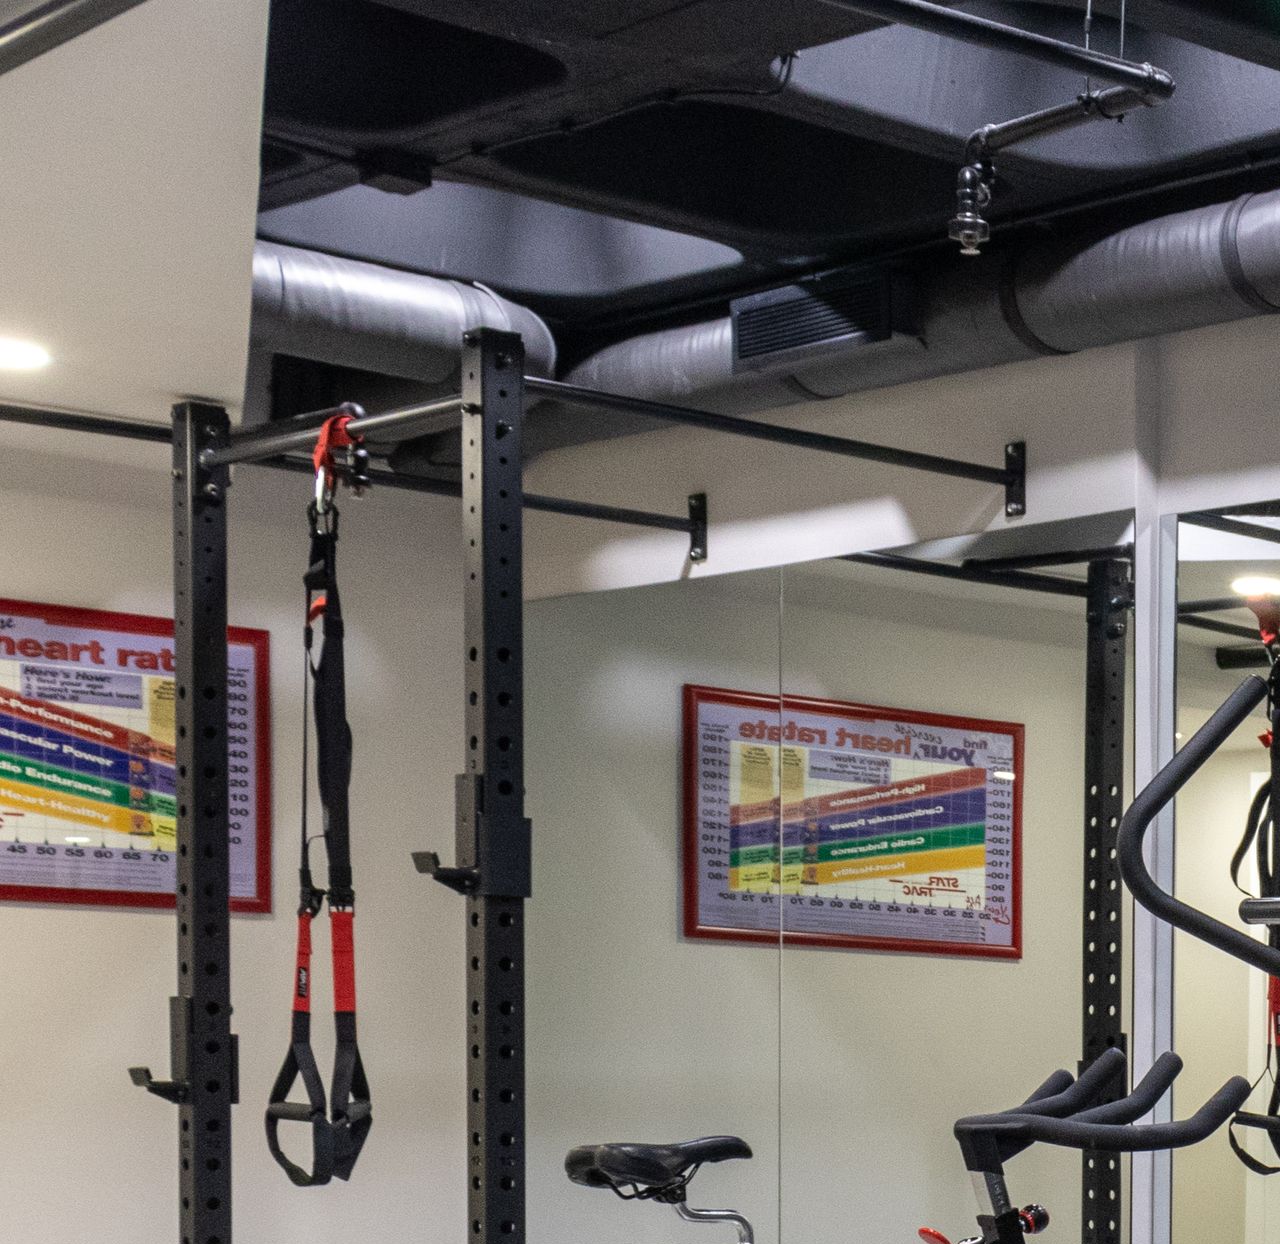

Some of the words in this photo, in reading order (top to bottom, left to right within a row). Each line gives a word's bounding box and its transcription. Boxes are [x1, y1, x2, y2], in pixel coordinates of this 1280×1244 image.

[116, 646, 176, 673] rat
[62, 745, 114, 768] Power
[25, 766, 112, 797] Endurance
